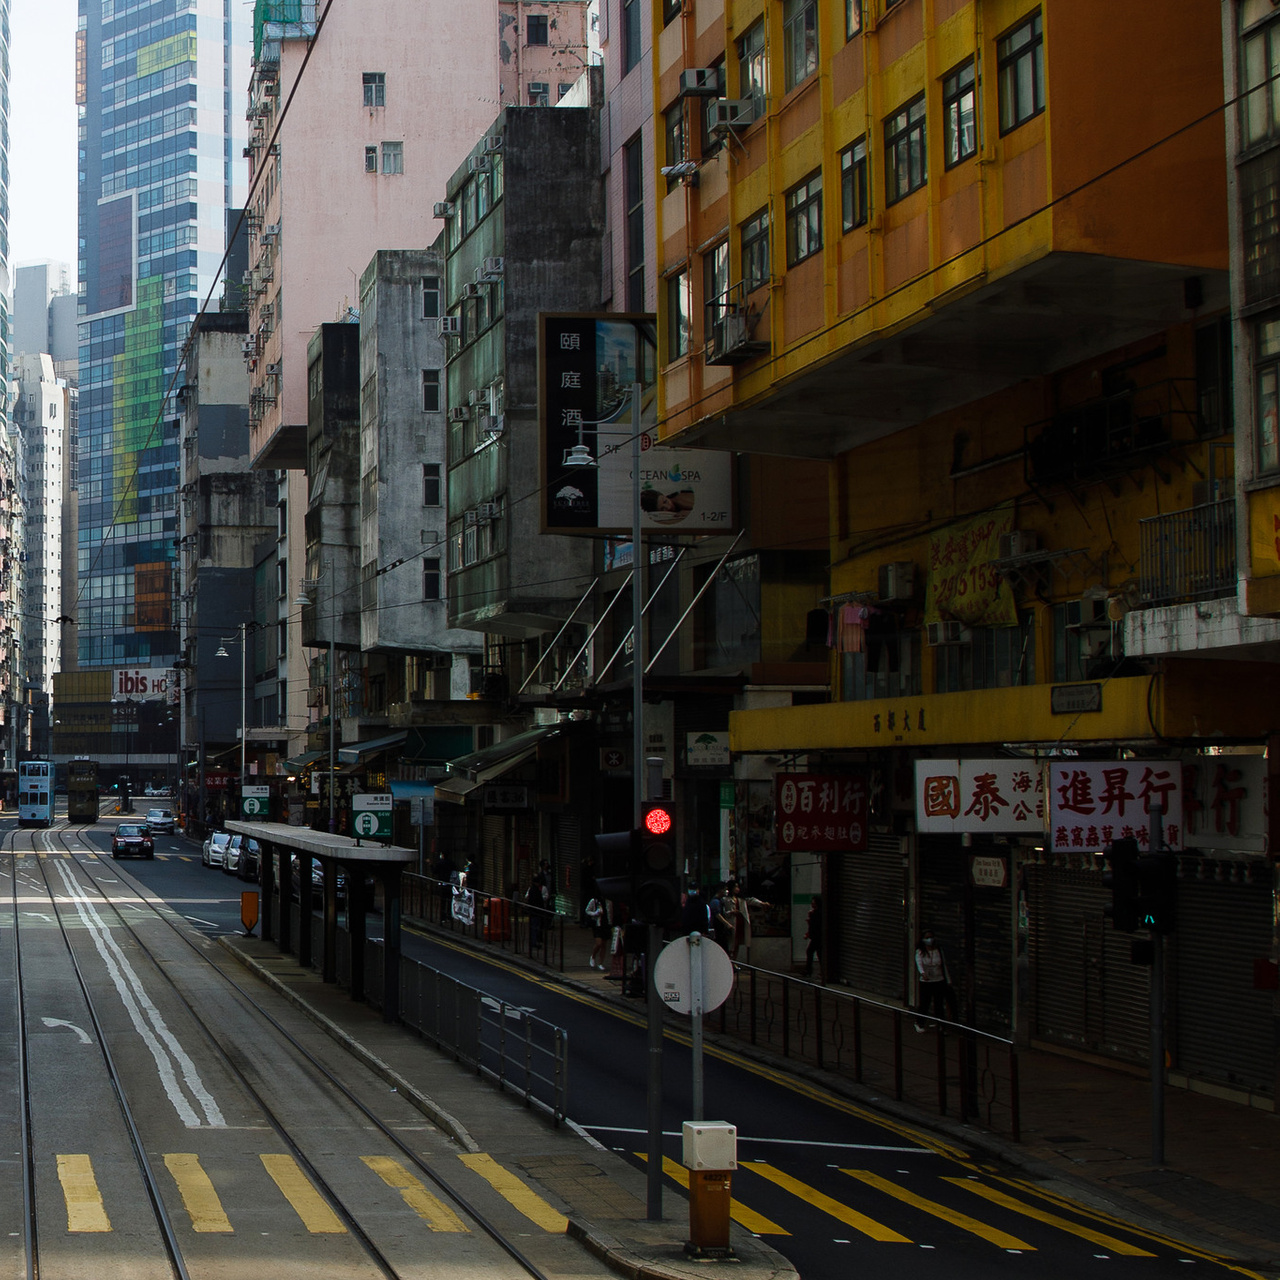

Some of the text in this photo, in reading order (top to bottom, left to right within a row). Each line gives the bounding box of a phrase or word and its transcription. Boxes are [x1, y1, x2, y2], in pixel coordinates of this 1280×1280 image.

[560, 332, 582, 466] 頤庭酒
[681, 470, 701, 481] SPA
[701, 512, 728, 522] 1-2/F
[119, 671, 148, 694] ibis
[797, 779, 865, 815] 百利行
[924, 772, 1010, 821] 國泰
[1057, 767, 1177, 818] 進昇行
